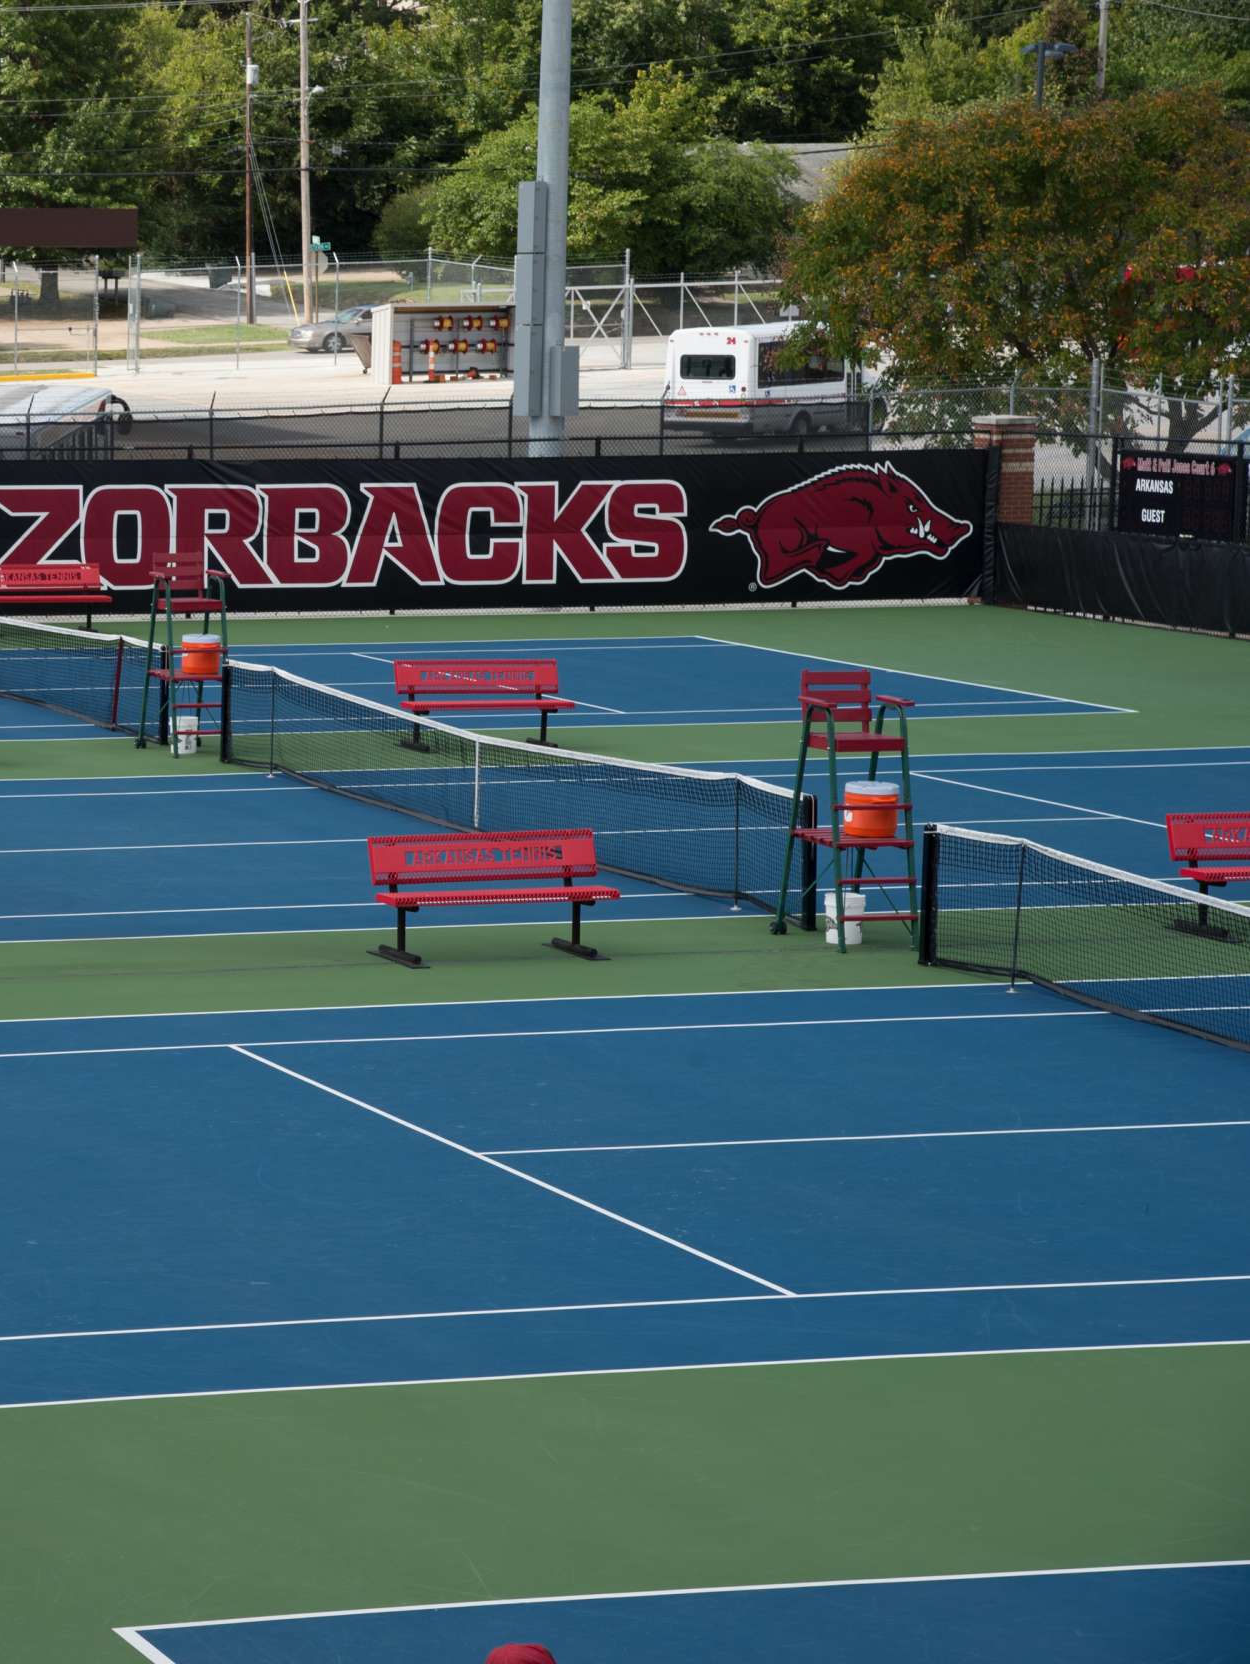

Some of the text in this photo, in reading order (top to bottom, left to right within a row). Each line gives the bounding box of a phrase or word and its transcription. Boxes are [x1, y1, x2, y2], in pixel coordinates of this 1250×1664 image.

[1136, 478, 1174, 494] ARKANSAS
[1141, 508, 1166, 523] GUEST
[413, 845, 558, 866] ARKANSAS TENNIS
